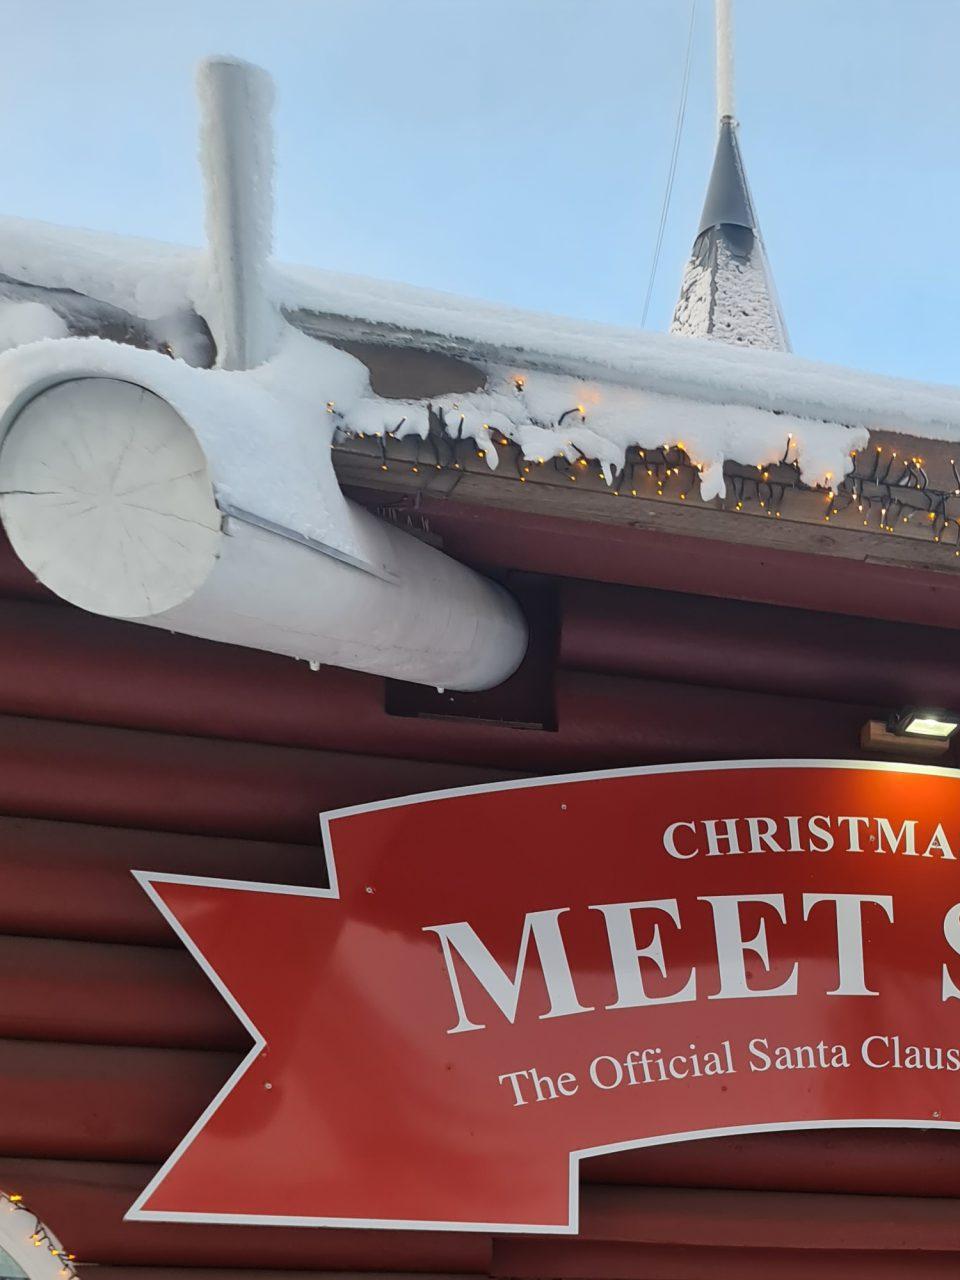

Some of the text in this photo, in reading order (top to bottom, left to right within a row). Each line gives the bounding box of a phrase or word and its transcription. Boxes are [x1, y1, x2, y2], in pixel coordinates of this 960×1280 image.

[421, 892, 894, 1034] MEET
[498, 1068, 579, 1107] The
[589, 1040, 736, 1089] Official
[748, 1037, 850, 1073] Santa
[861, 1035, 960, 1072] Claus
